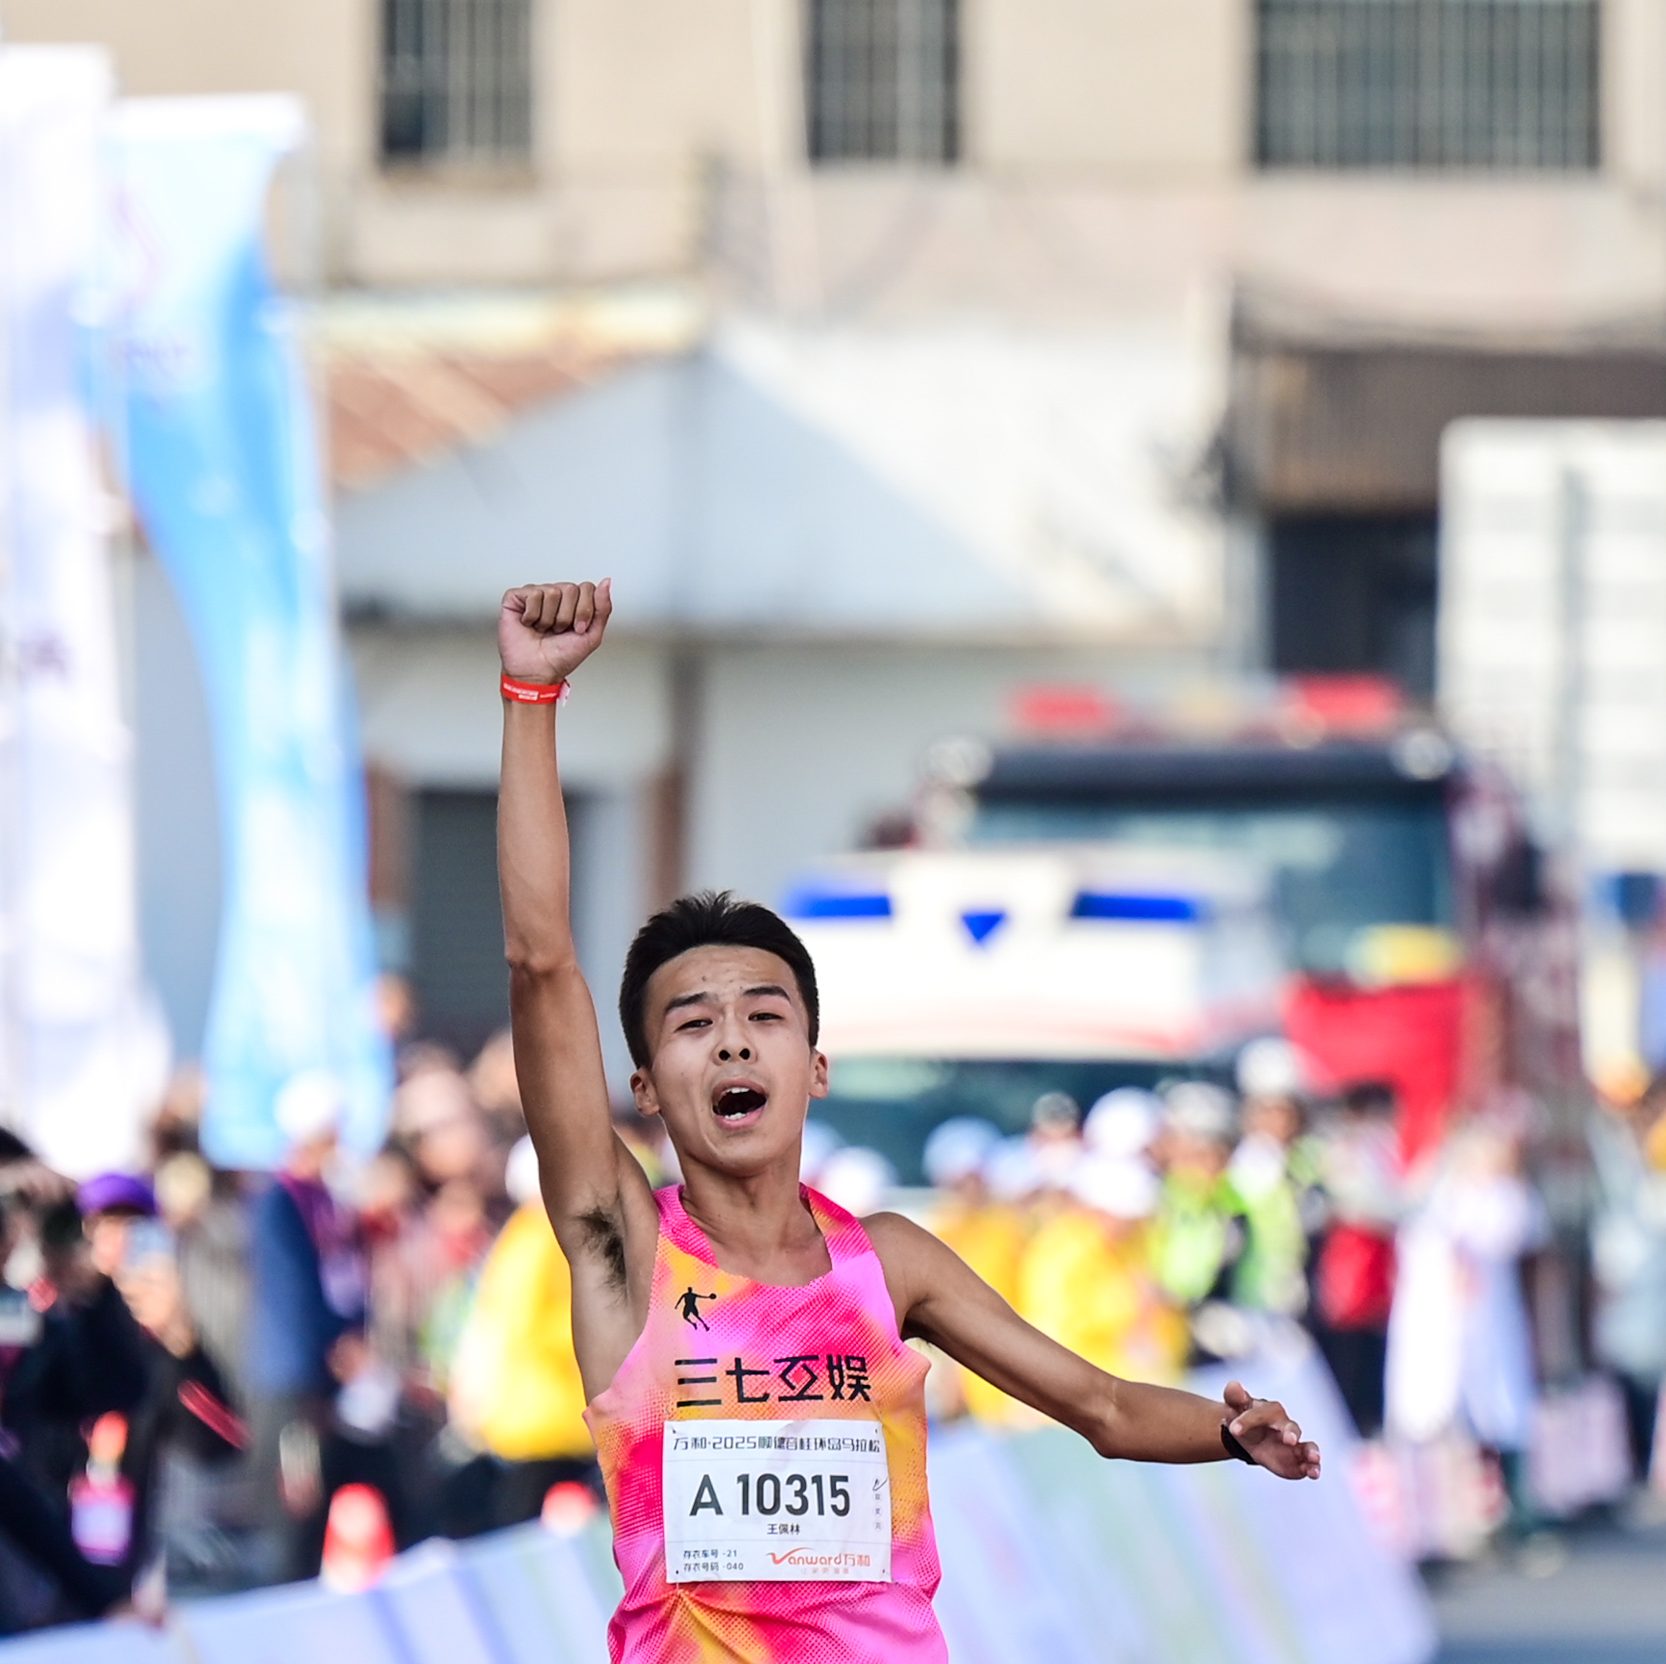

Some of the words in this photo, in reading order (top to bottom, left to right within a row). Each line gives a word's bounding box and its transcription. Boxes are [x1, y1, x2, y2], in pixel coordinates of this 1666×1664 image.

[674, 1354, 872, 1408] 三七互娱
[690, 1474, 723, 1516] A
[737, 1473, 850, 1517] 10315
[766, 1547, 842, 1566] Vanward
[843, 1553, 871, 1567] 万和
